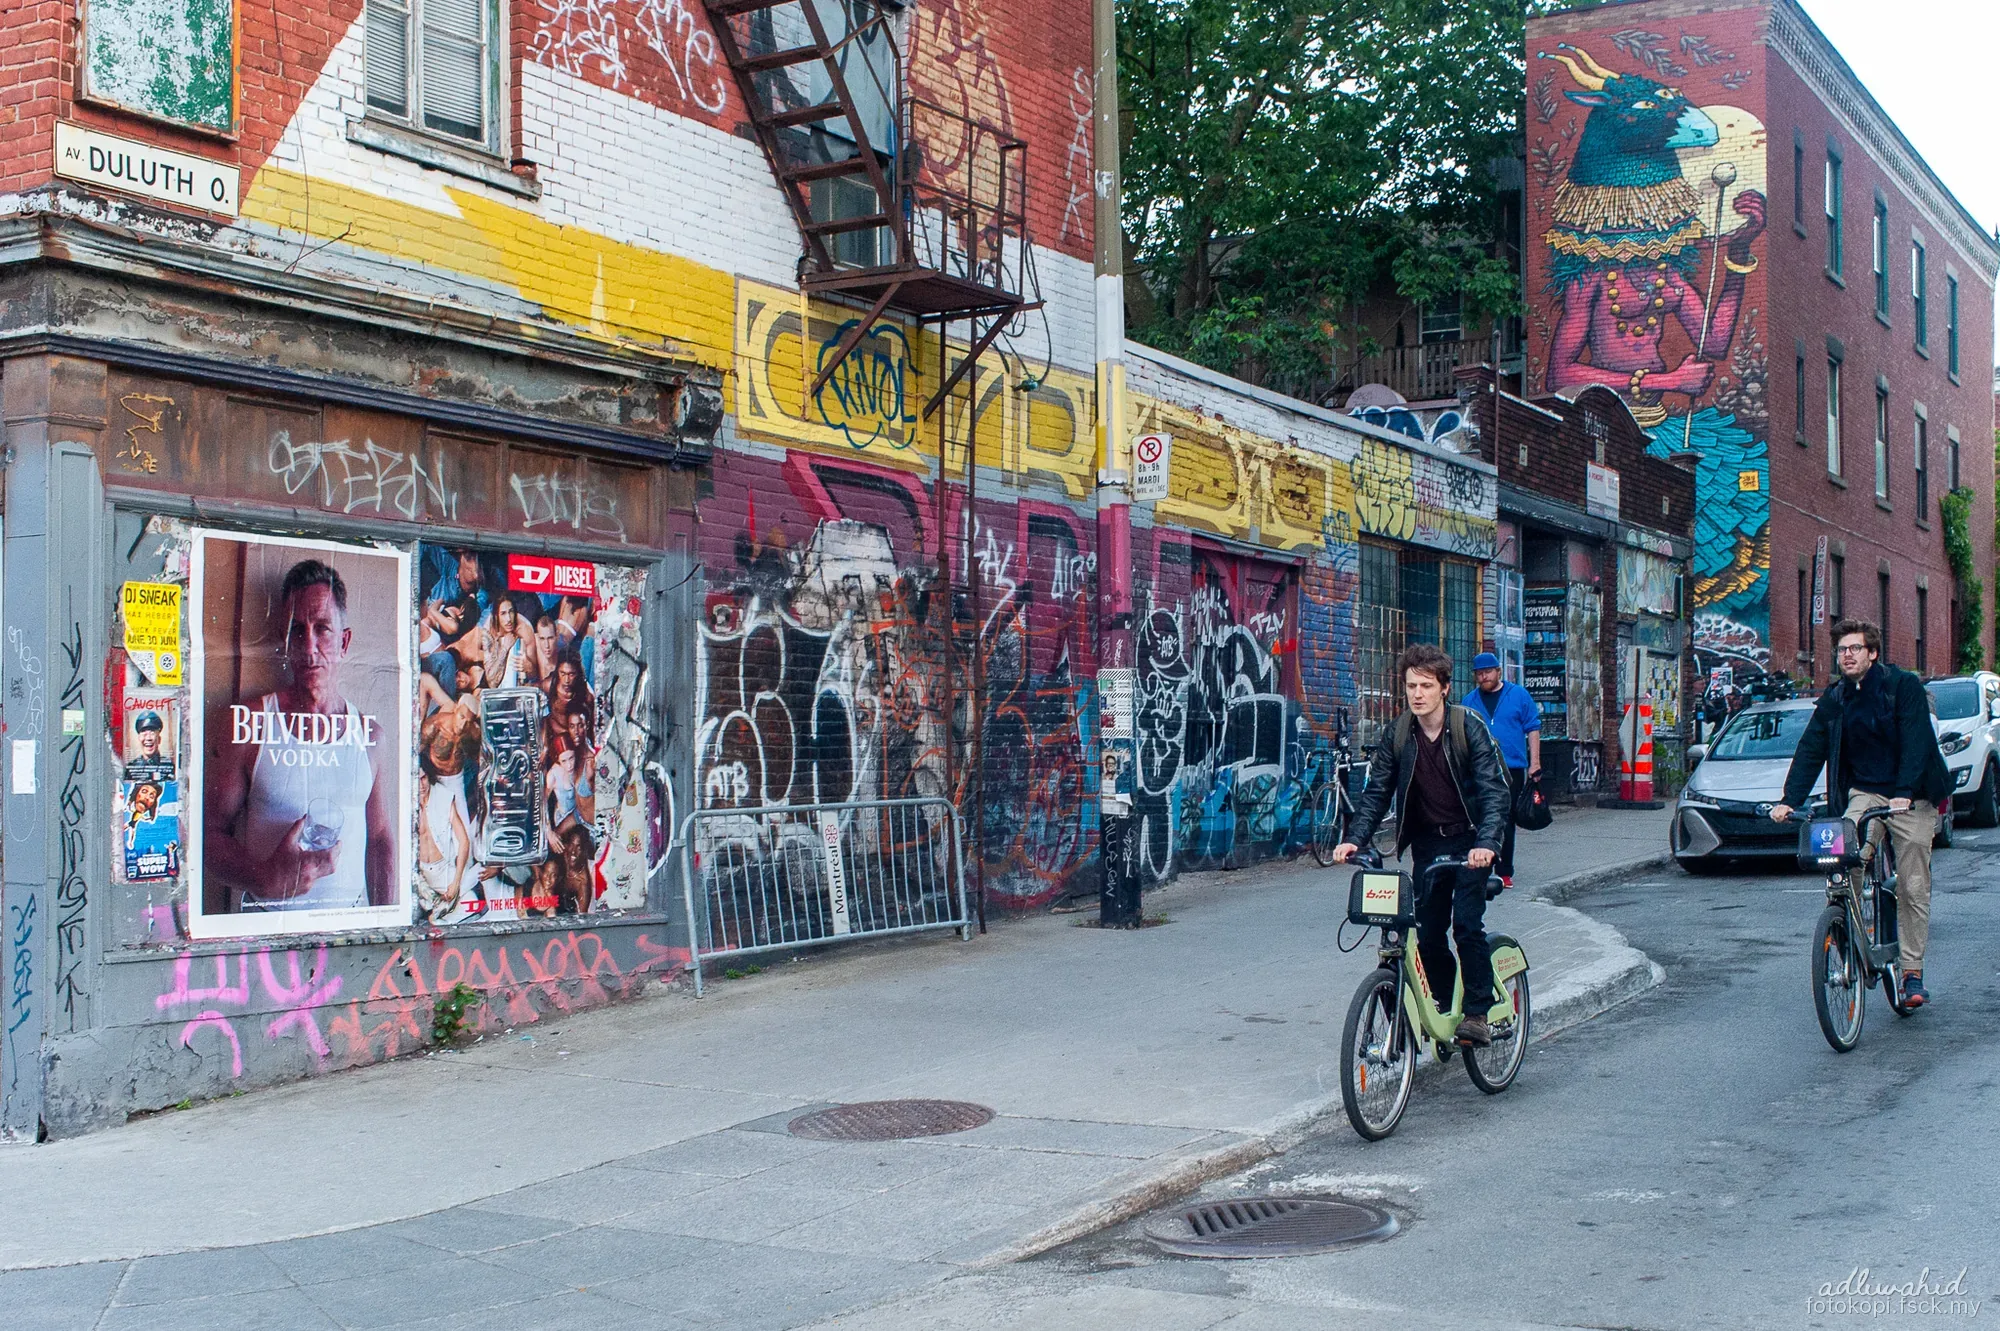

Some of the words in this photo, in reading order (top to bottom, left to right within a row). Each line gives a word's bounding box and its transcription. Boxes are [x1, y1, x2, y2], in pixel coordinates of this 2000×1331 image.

[65, 146, 85, 162] AV.
[89, 145, 193, 196] DULUTH
[211, 177, 230, 204] O.
[1137, 463, 1146, 473] 8h
[1151, 462, 1160, 472] 9h
[1137, 475, 1160, 485] MARDI
[554, 564, 593, 589] DIESEL
[125, 587, 137, 604] DJ
[139, 589, 178, 607] SNEAK
[123, 697, 177, 711] CAUGHT.
[229, 704, 377, 752] BELVEDERE
[268, 748, 341, 767] VODKA
[137, 855, 168, 866] SUPER
[140, 864, 167, 875] WOW
[828, 844, 845, 914] Montréal
[489, 898, 503, 911] THE
[504, 896, 520, 910] NEW
